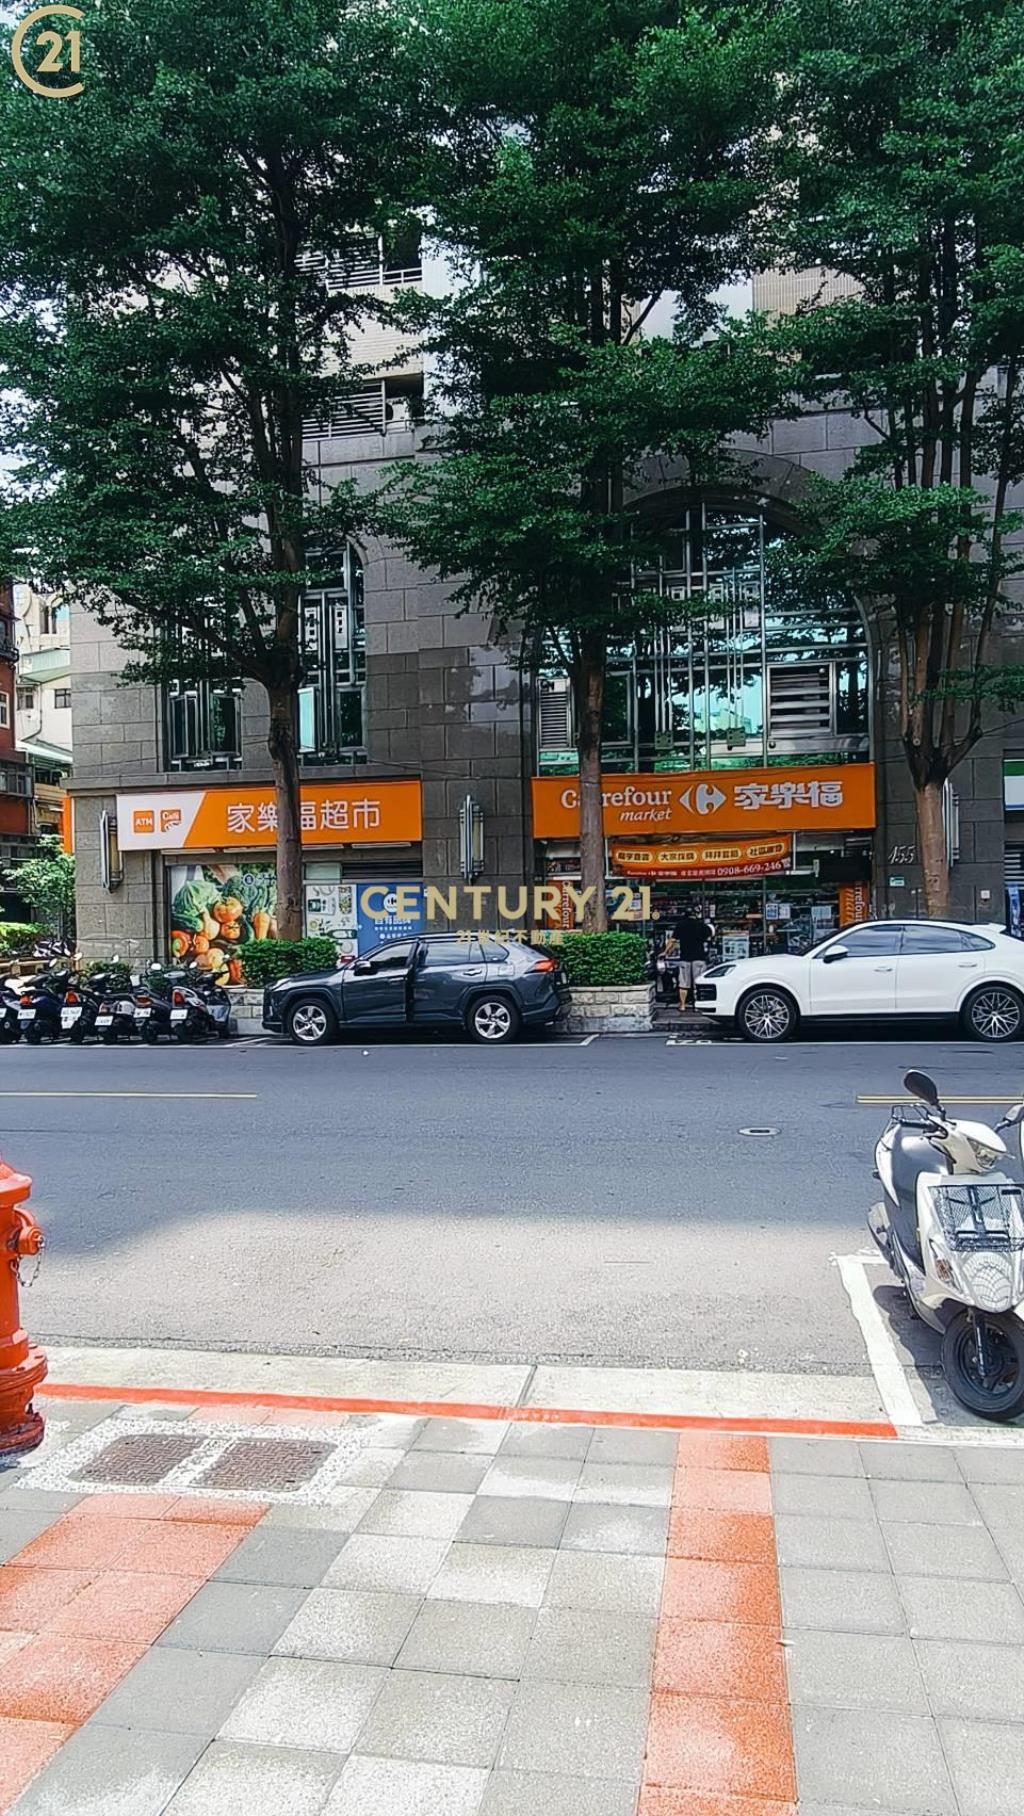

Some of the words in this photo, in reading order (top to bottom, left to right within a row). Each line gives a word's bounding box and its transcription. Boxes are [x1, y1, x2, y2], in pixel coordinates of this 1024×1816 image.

[561, 786, 672, 809] Crefour
[733, 781, 843, 810] 家樂福
[135, 817, 153, 827] ATM
[227, 798, 381, 833] 家樂福超市
[619, 807, 672, 822] market
[888, 845, 915, 864] 155
